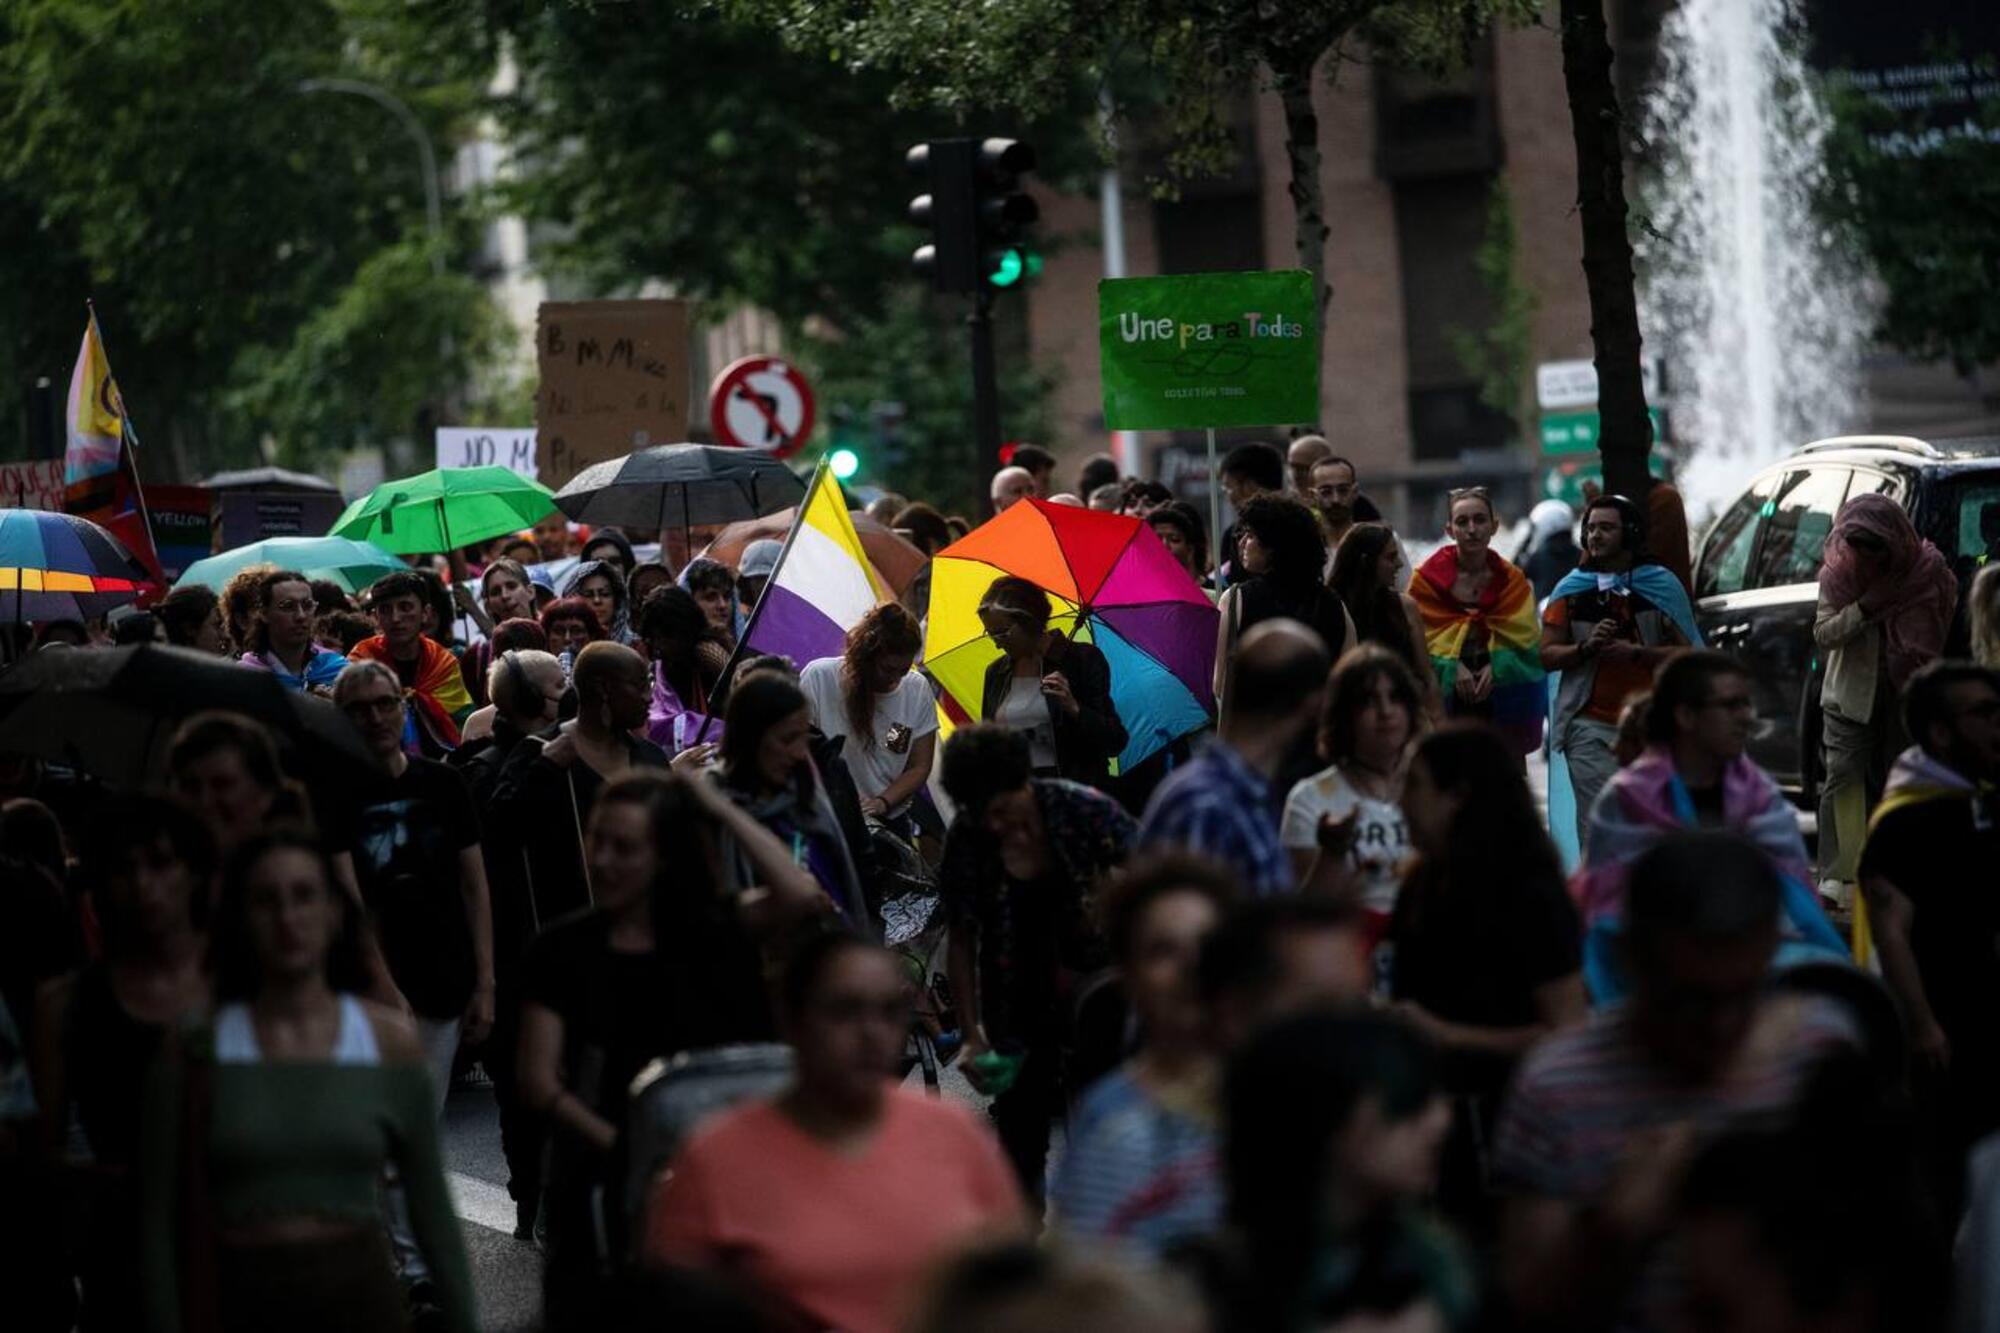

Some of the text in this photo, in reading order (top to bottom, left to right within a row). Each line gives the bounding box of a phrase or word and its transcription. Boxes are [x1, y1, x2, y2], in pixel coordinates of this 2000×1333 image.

[1120, 311, 1303, 349] Une para Todes
[154, 511, 208, 527] YELLOW
